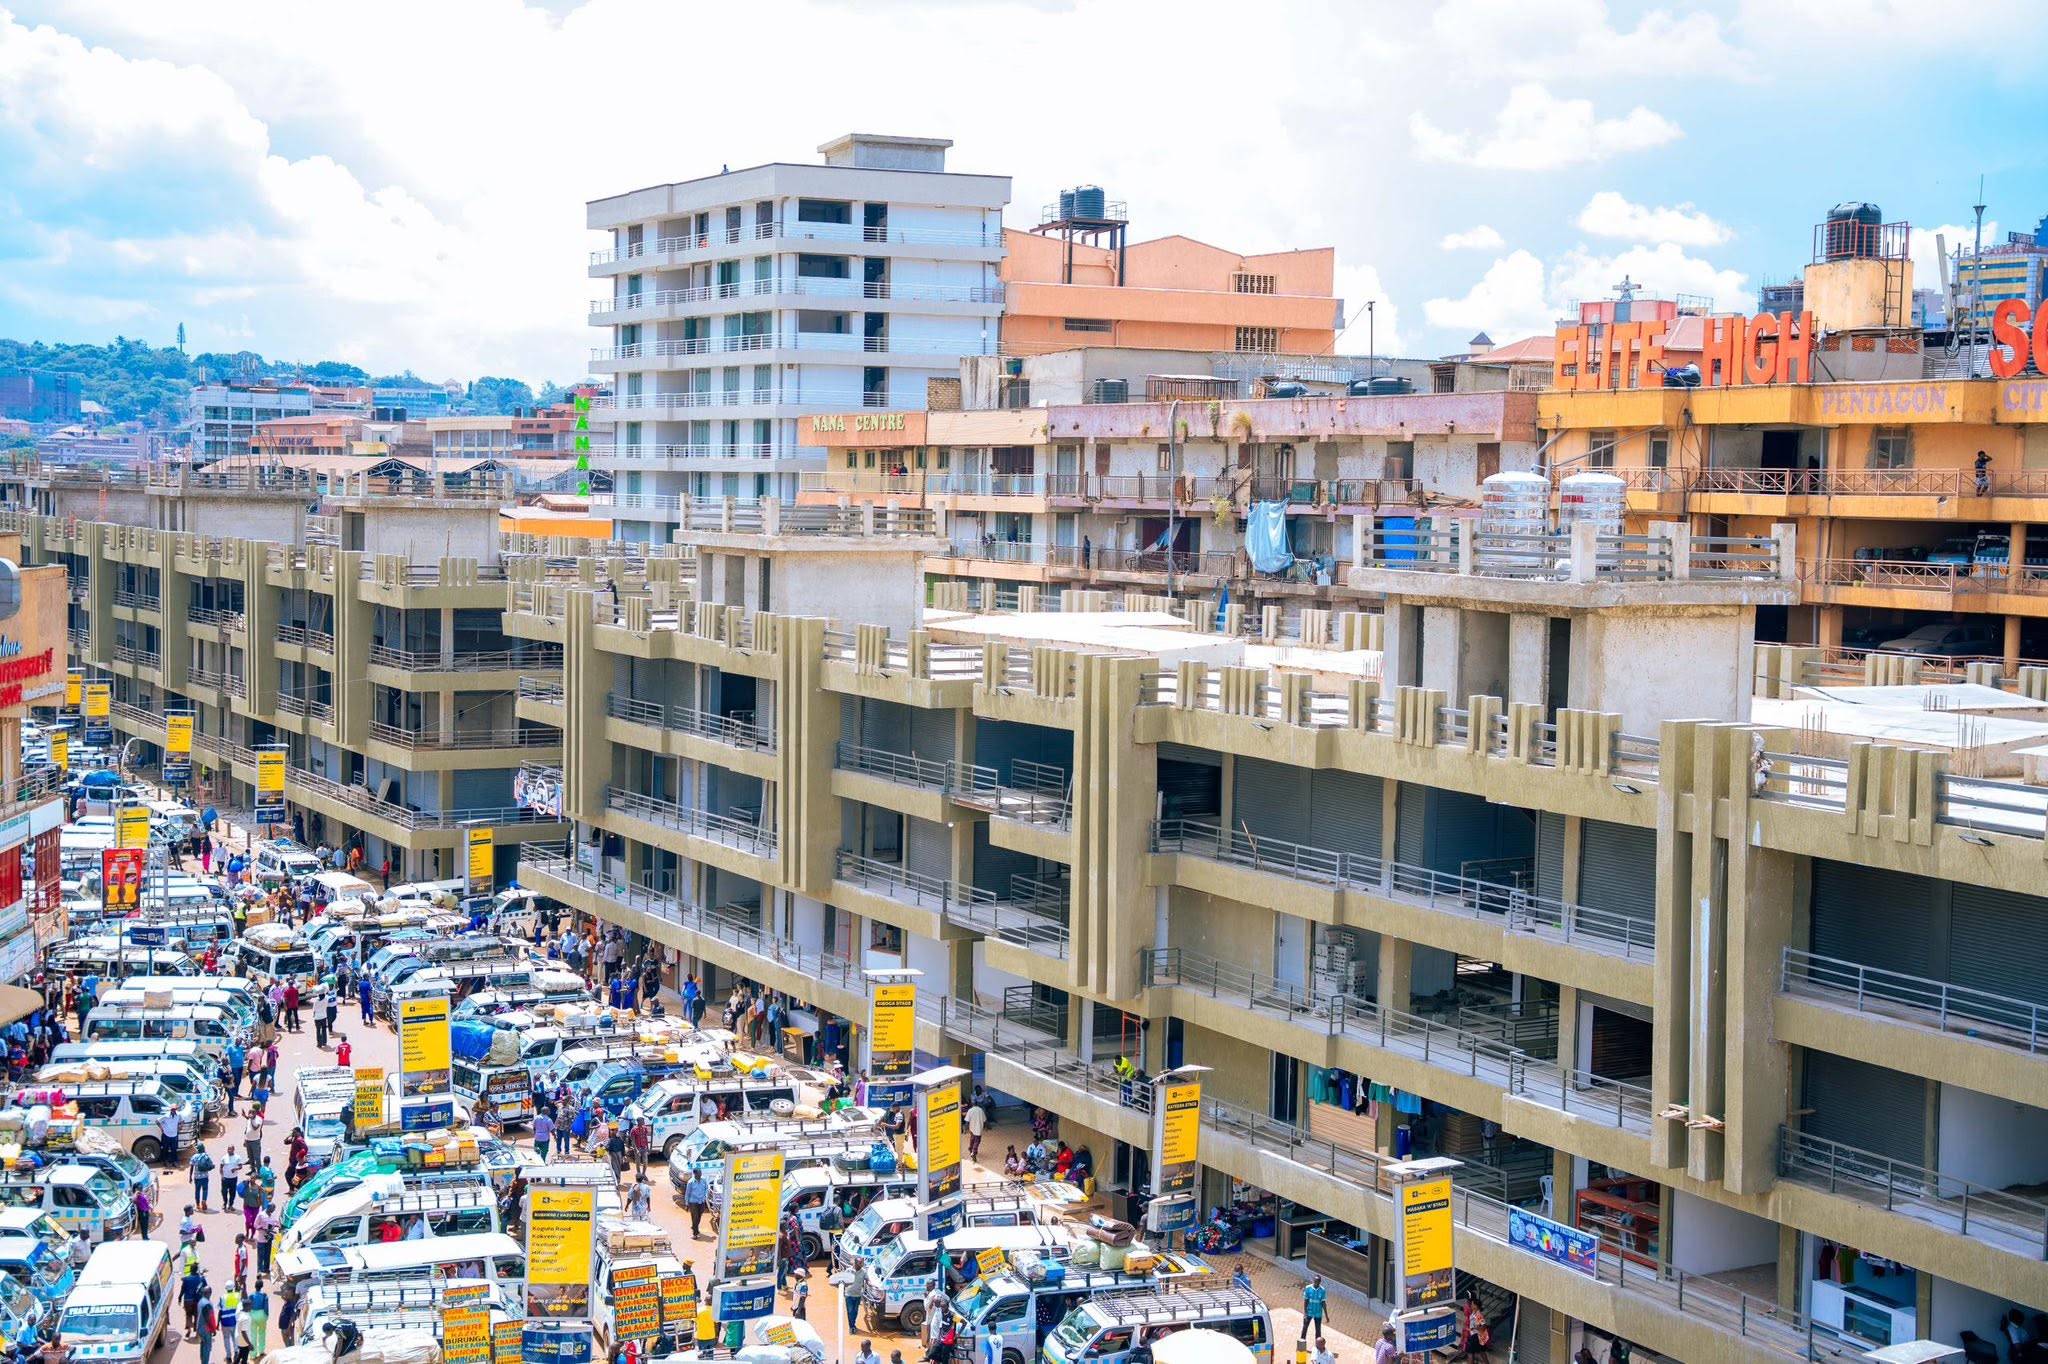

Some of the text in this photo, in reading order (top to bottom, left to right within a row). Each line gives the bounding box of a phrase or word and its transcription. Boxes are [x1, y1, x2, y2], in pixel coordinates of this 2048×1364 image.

[1554, 319, 1668, 390] ELITE
[1703, 310, 1813, 386] HIGH
[1822, 383, 1947, 415] PENTAGON
[813, 414, 906, 432] NANA CENTRE
[574, 396, 590, 497] NANA 2
[616, 1284, 657, 1296] BUWAMA
[446, 1336, 486, 1344] BURUNGA
